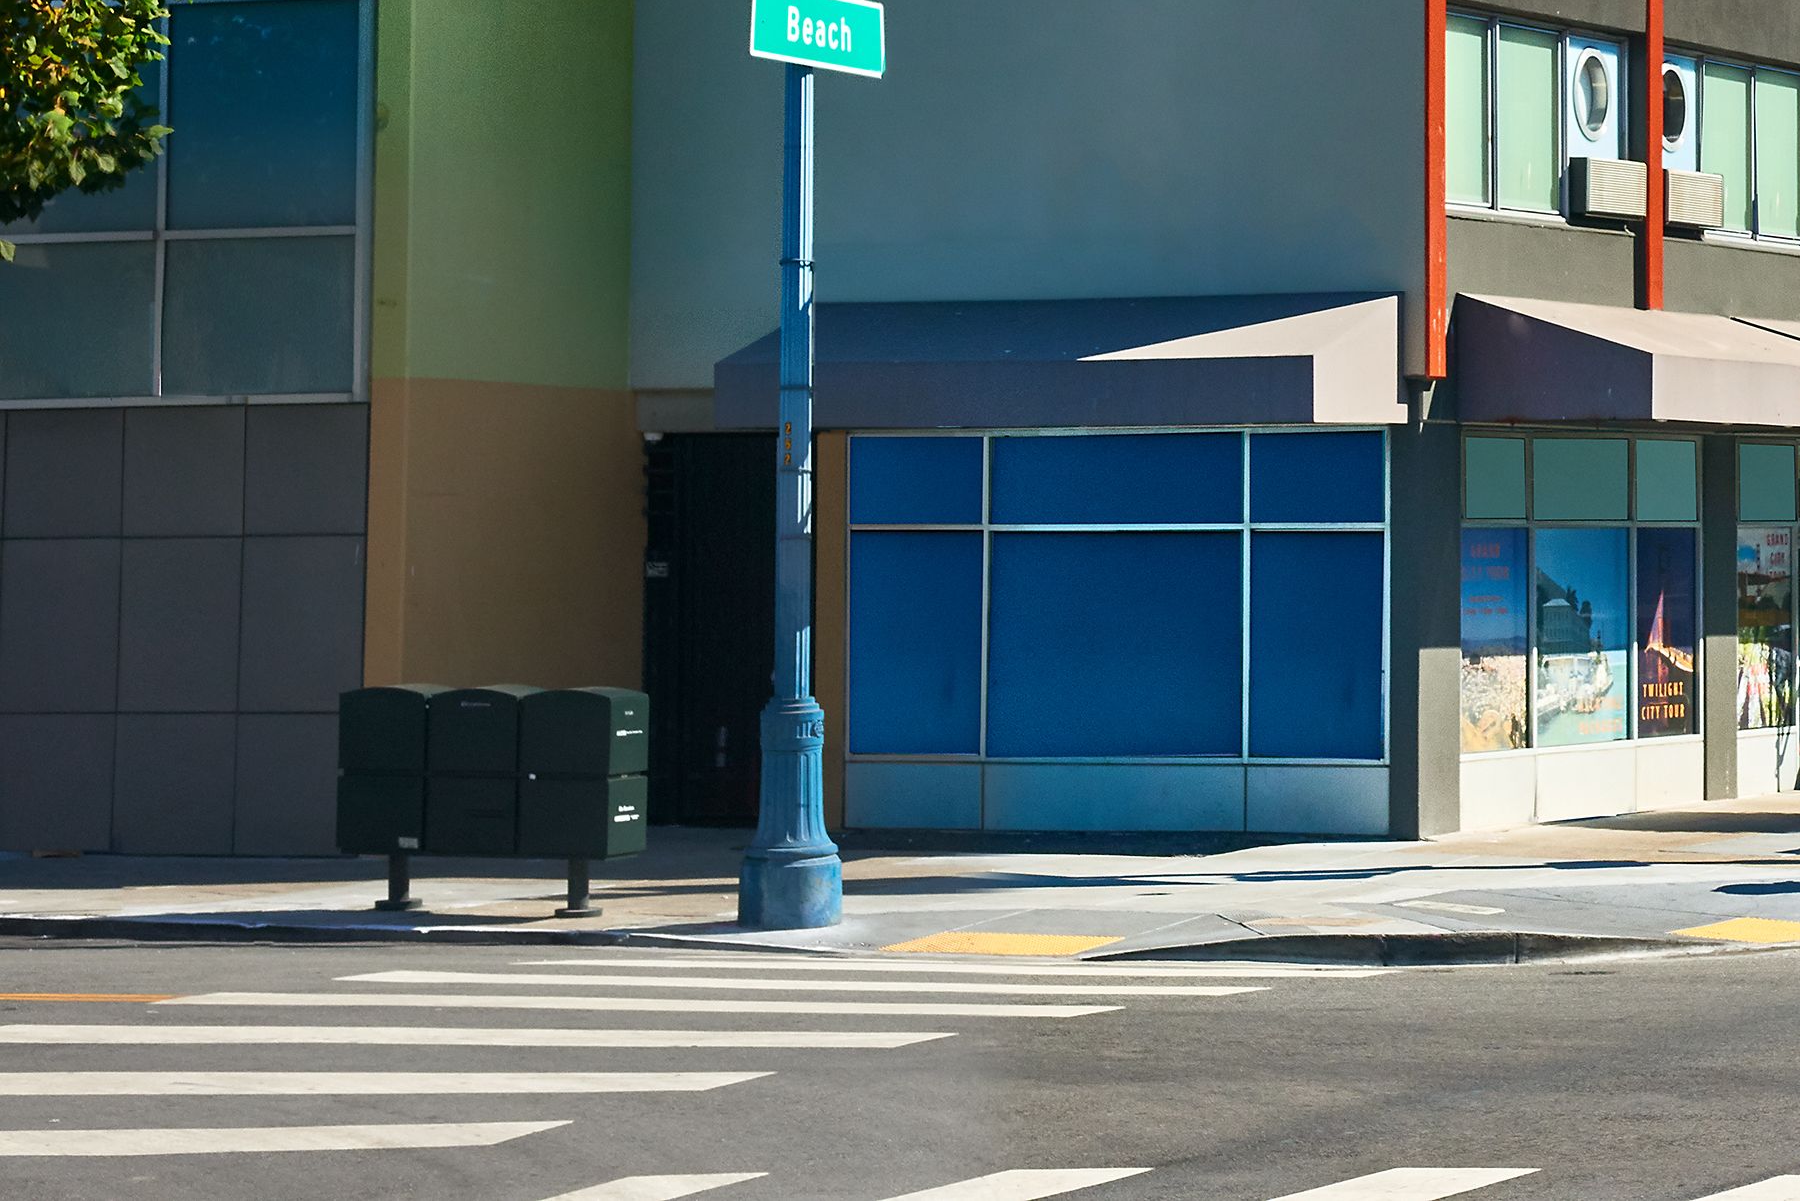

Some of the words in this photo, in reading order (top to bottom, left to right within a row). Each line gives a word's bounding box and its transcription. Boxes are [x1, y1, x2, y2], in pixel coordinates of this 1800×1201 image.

[786, 5, 852, 52] Beach
[1642, 682, 1683, 697] TWILIGHT
[1641, 706, 1660, 720] CITY
[1663, 704, 1685, 719] TOUR
